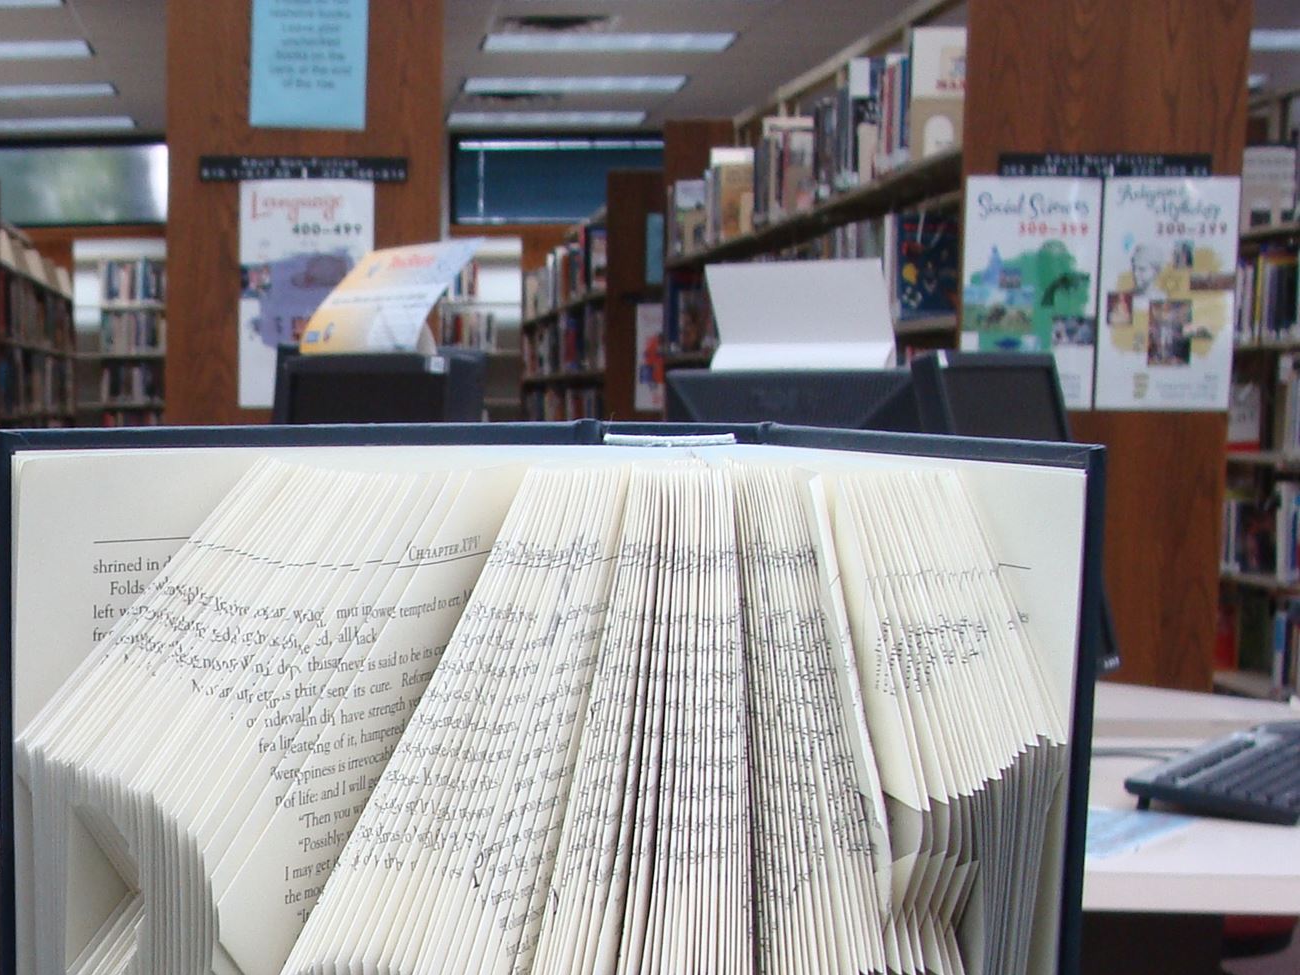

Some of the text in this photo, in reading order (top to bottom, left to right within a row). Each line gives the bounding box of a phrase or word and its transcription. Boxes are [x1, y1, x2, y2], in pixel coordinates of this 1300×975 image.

[92, 556, 142, 574] shrined
[146, 558, 160, 571] in
[110, 579, 145, 596] Folds
[93, 604, 115, 620] left
[400, 595, 437, 619] tempted
[378, 652, 397, 670] said
[340, 708, 365, 725] have
[367, 696, 406, 720] strength
[333, 735, 345, 750] of
[283, 793, 297, 809] of
[320, 782, 340, 800] and
[348, 775, 367, 792] will
[333, 808, 351, 825] you
[292, 863, 315, 880] may
[315, 859, 331, 877] get
[284, 888, 302, 905] the
